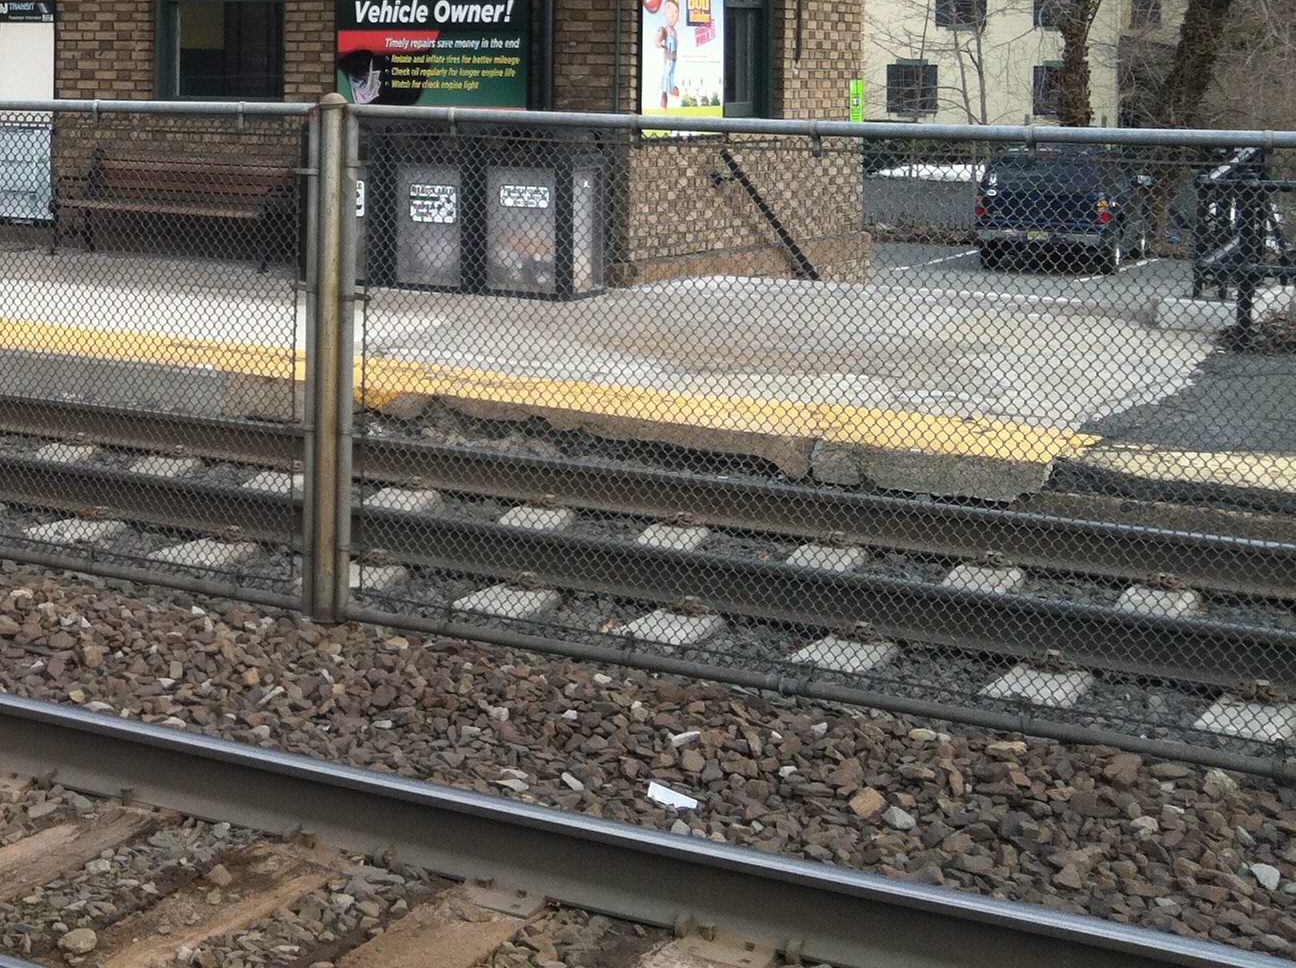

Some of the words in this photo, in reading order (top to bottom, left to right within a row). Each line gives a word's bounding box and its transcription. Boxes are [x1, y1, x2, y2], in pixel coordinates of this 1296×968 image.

[0, 2, 8, 14] NJ
[9, 2, 35, 11] TRANSIT
[354, 0, 429, 23] Vehicle
[433, 0, 515, 23] Owner!
[385, 38, 410, 50] Timely
[410, 38, 436, 49] repairs
[437, 39, 454, 48] save
[454, 39, 480, 49] money
[481, 38, 489, 48] in
[490, 38, 503, 48] the
[504, 38, 520, 48] end
[426, 55, 445, 63] inflate
[472, 55, 493, 63] better
[494, 55, 520, 65] mileage
[391, 67, 410, 76] Check
[411, 67, 420, 76] oil
[420, 68, 448, 77] regularly
[448, 68, 458, 76] for
[459, 68, 480, 77] longer
[481, 68, 503, 78] engine
[411, 80, 421, 88] for
[422, 80, 440, 88] check
[441, 81, 462, 90] engine
[463, 80, 479, 90] light
